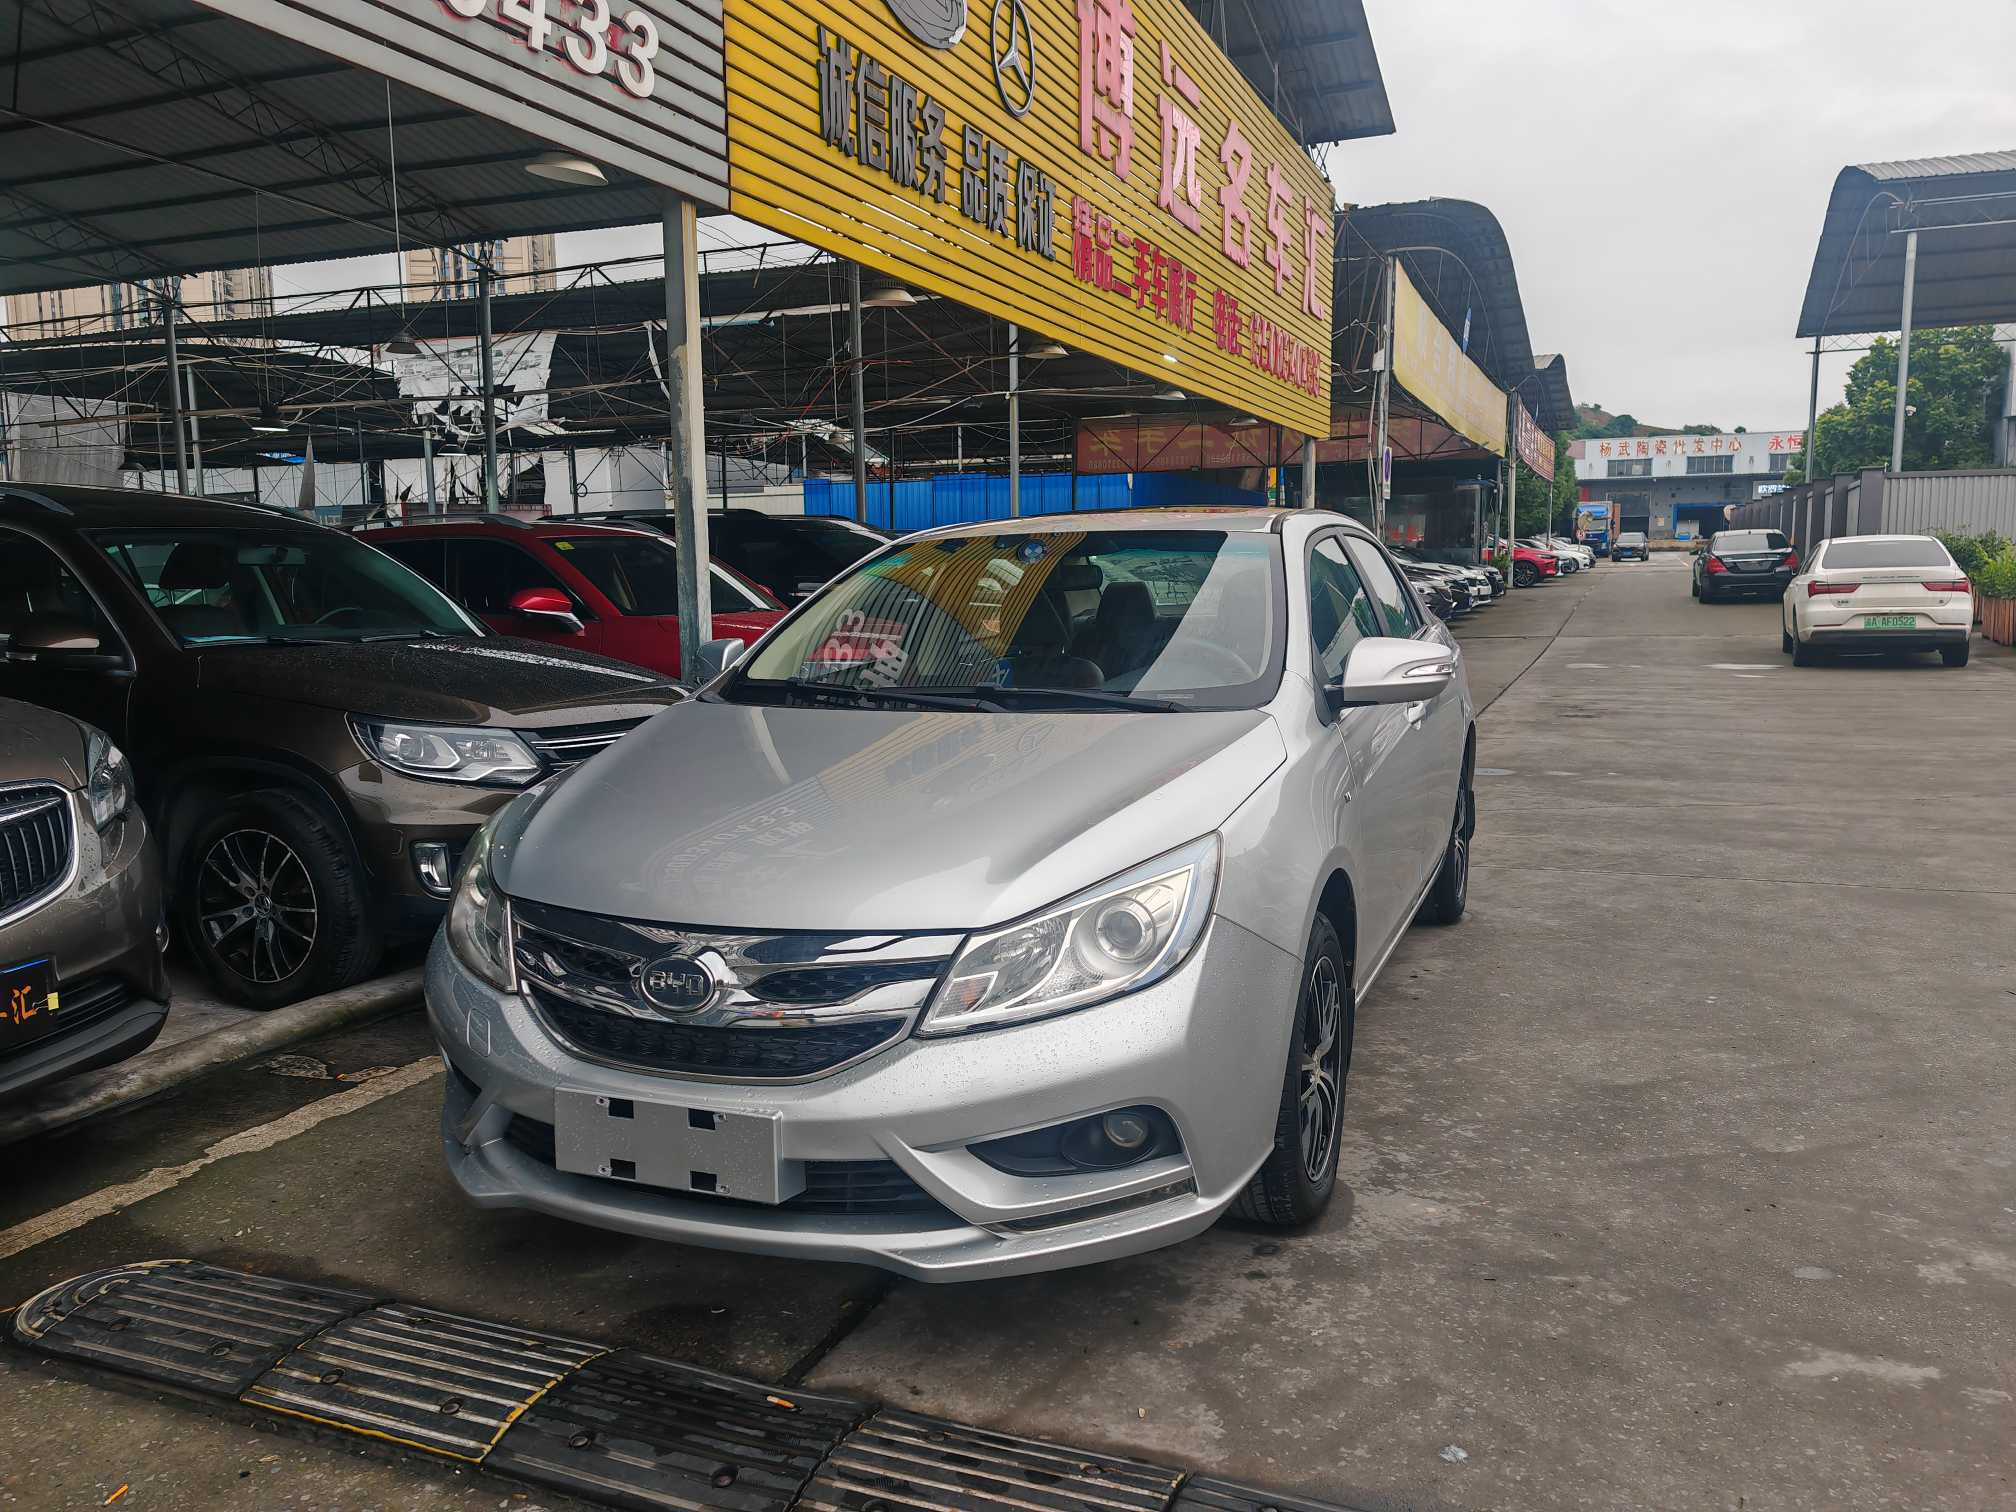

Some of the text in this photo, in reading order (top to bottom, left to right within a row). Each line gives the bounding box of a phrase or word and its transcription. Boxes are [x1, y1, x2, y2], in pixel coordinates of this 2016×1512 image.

[442, 0, 660, 98] 433
[816, 23, 1057, 262] 诚信服务 品质 保证
[1076, 0, 1325, 321] 博远名车汇
[649, 970, 704, 996] BYD
